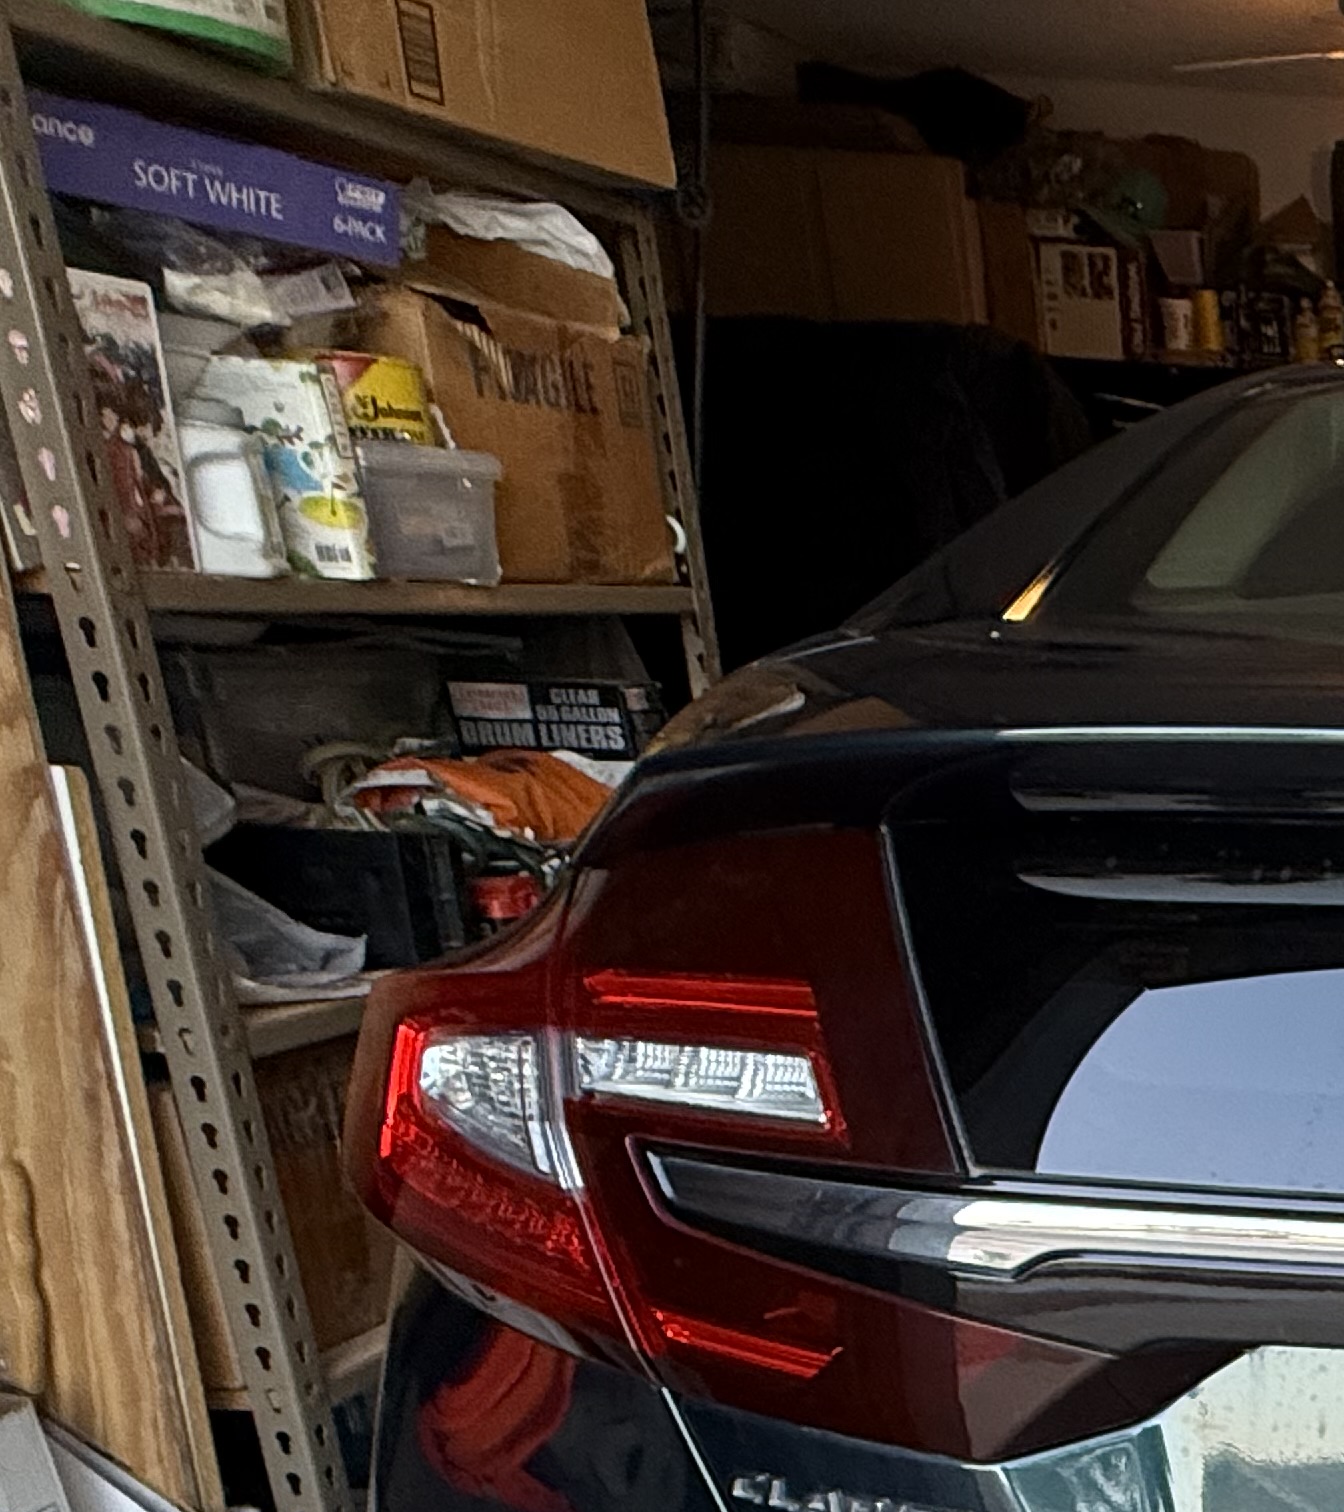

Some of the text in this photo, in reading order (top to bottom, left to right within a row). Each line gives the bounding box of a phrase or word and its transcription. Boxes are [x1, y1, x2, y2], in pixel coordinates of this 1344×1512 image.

[133, 158, 284, 221] SOFT WHITE
[461, 721, 626, 749] DRUM LINERS
